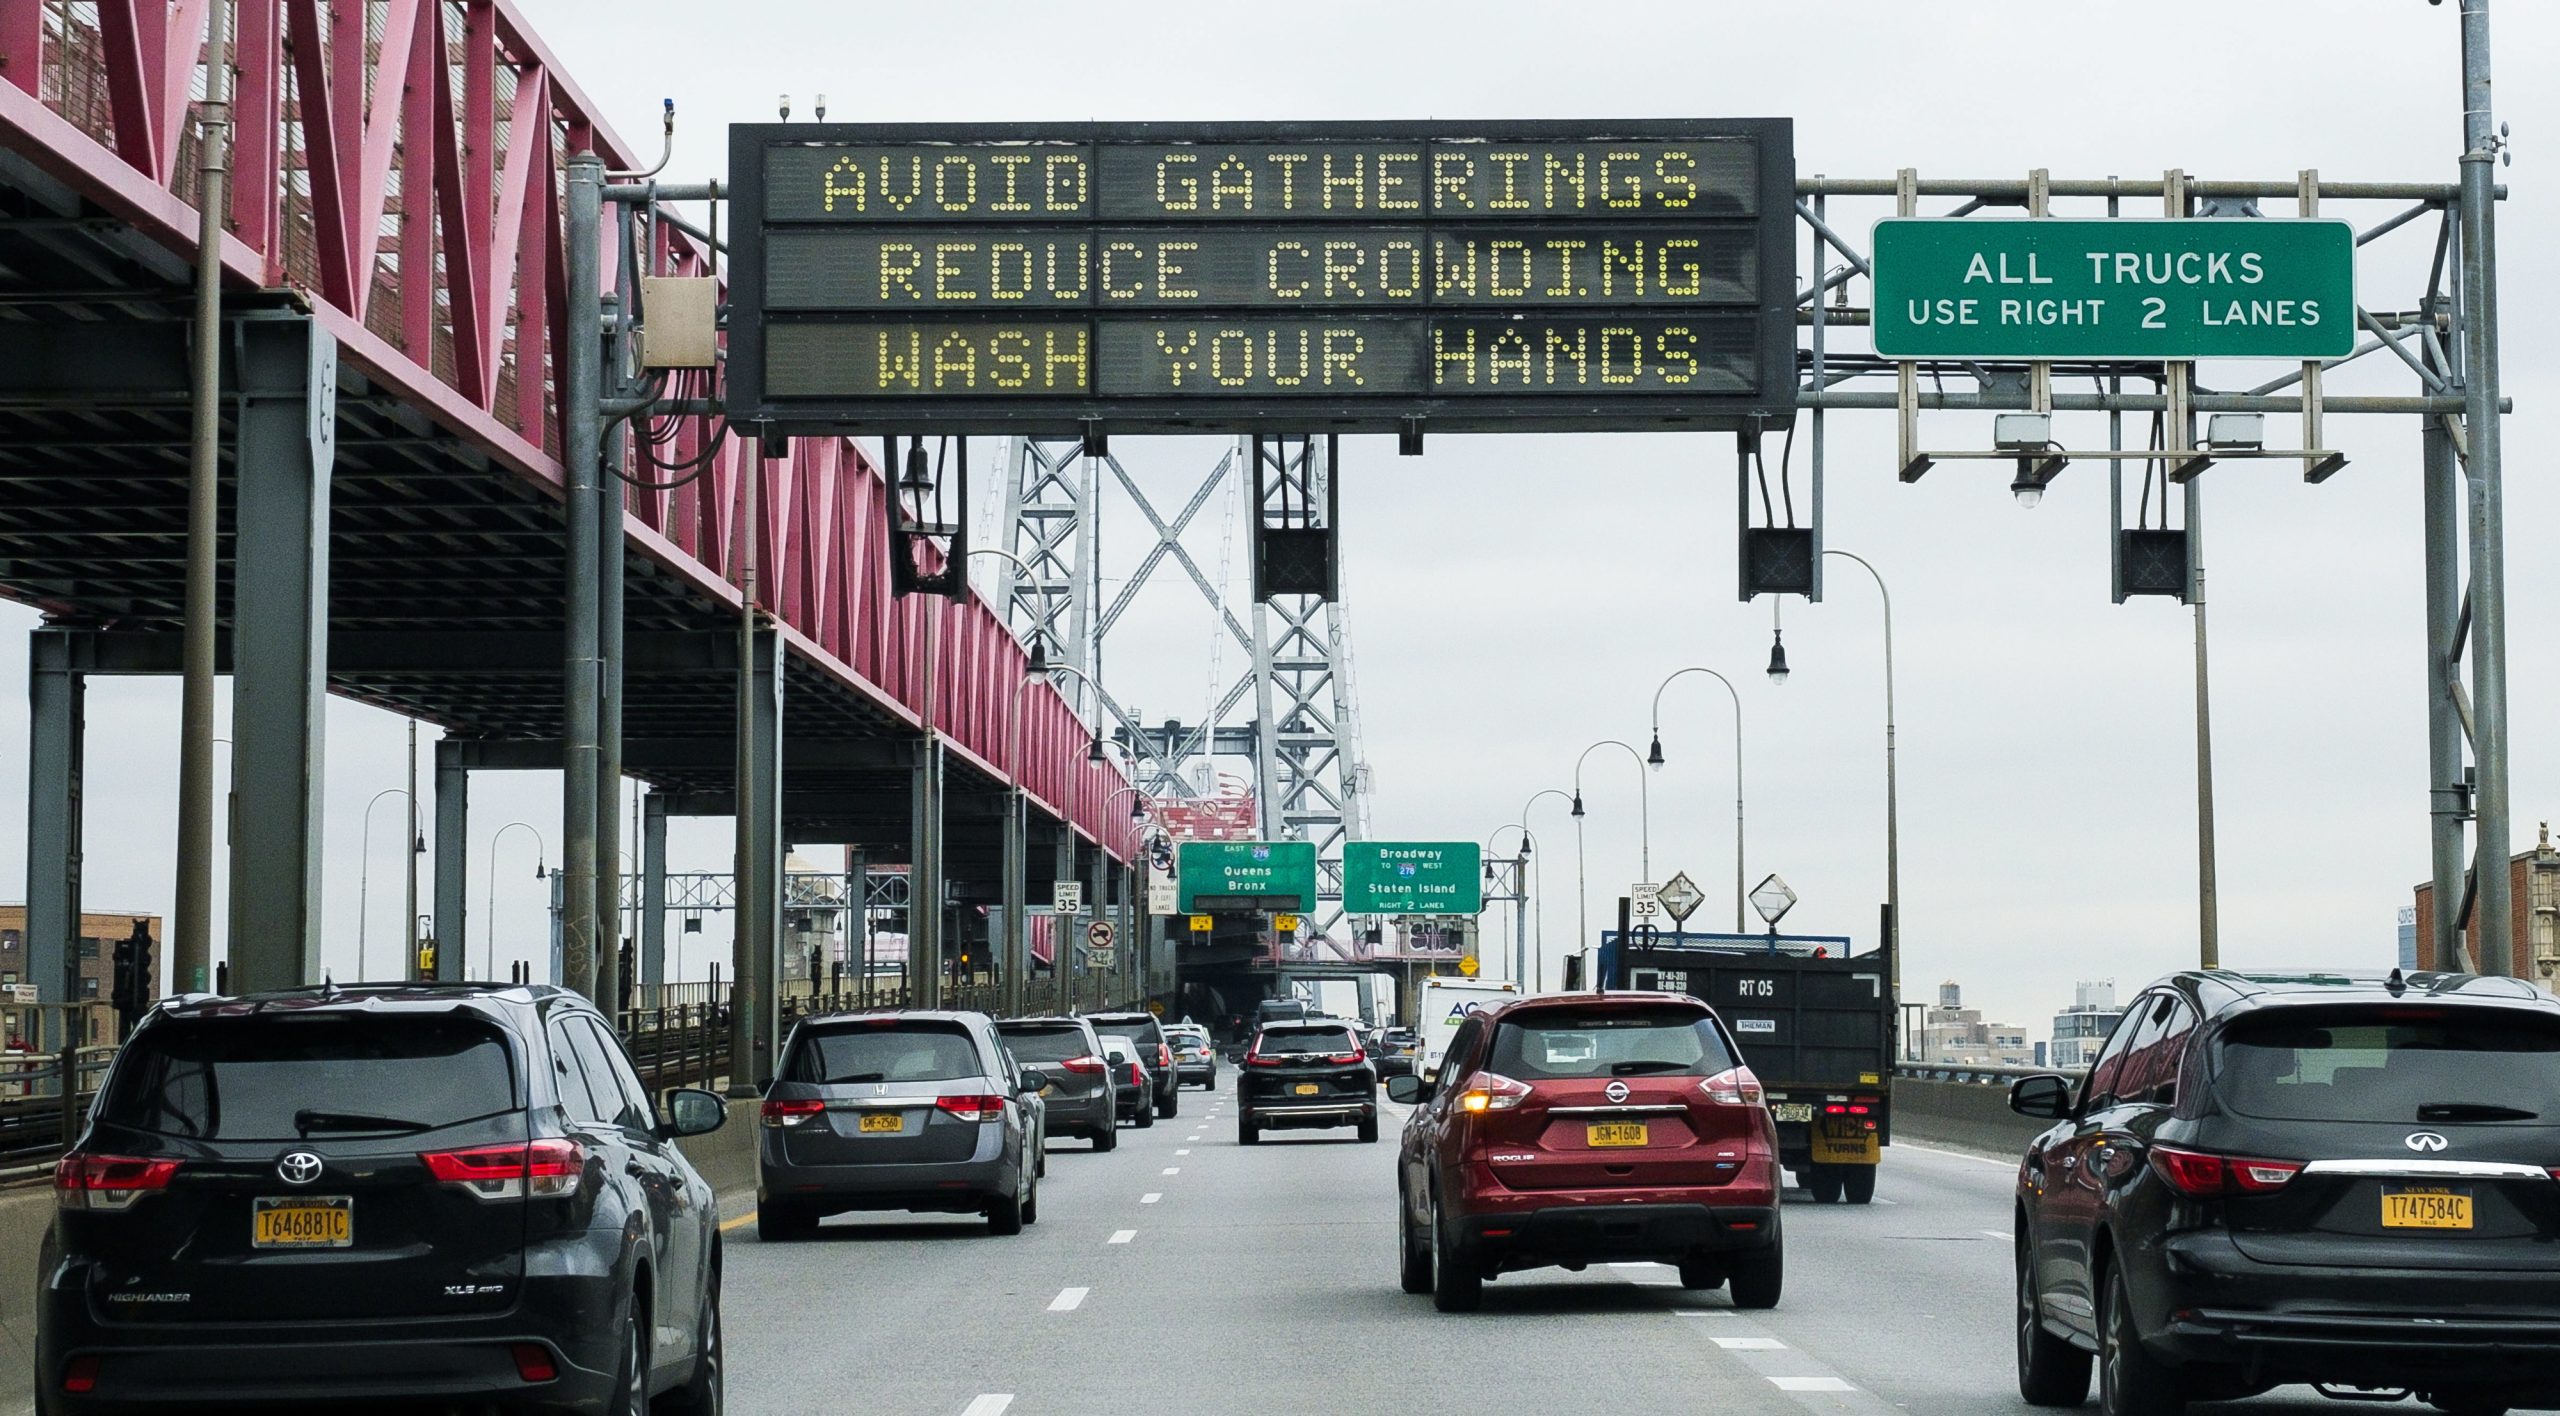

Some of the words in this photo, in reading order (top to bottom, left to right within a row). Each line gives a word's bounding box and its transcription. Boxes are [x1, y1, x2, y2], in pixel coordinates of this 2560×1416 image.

[823, 153, 1088, 213] AVOID
[1156, 151, 1698, 212] GATHERINGS
[879, 242, 1200, 300] REDUCE
[1267, 240, 1701, 298] CROWDING
[1963, 252, 2054, 285] ALL
[2086, 252, 2265, 286] TRUCKS
[1908, 299, 1979, 326] USE
[2000, 299, 2106, 326] RIGHT
[2140, 297, 2168, 330] 2
[2203, 300, 2321, 327] LANES
[877, 329, 1087, 389] WASH
[1156, 328, 1365, 388] YOUR
[1433, 326, 1700, 386] HANDS
[1253, 850, 1270, 858] 278
[1380, 848, 1442, 860] Broadway
[1224, 866, 1272, 876] Queens
[1399, 867, 1415, 875] 278
[1228, 880, 1267, 891] Bronx
[1369, 883, 1412, 893] Staten
[1419, 884, 1456, 893] Island
[1057, 899, 1078, 912] 35
[1407, 900, 1416, 911] 2
[1636, 901, 1656, 914] 35
[1739, 980, 1755, 996] RT
[1757, 980, 1774, 996] 05
[1826, 1143, 1868, 1154] TURNS
[1492, 1154, 1535, 1162] ROGUE
[2390, 1196, 2464, 1220] T747584C
[262, 1211, 344, 1237] T646881C
[443, 1285, 475, 1295] XLE
[476, 1285, 504, 1294] AWD
[108, 1293, 191, 1302] HIGHLANDER
